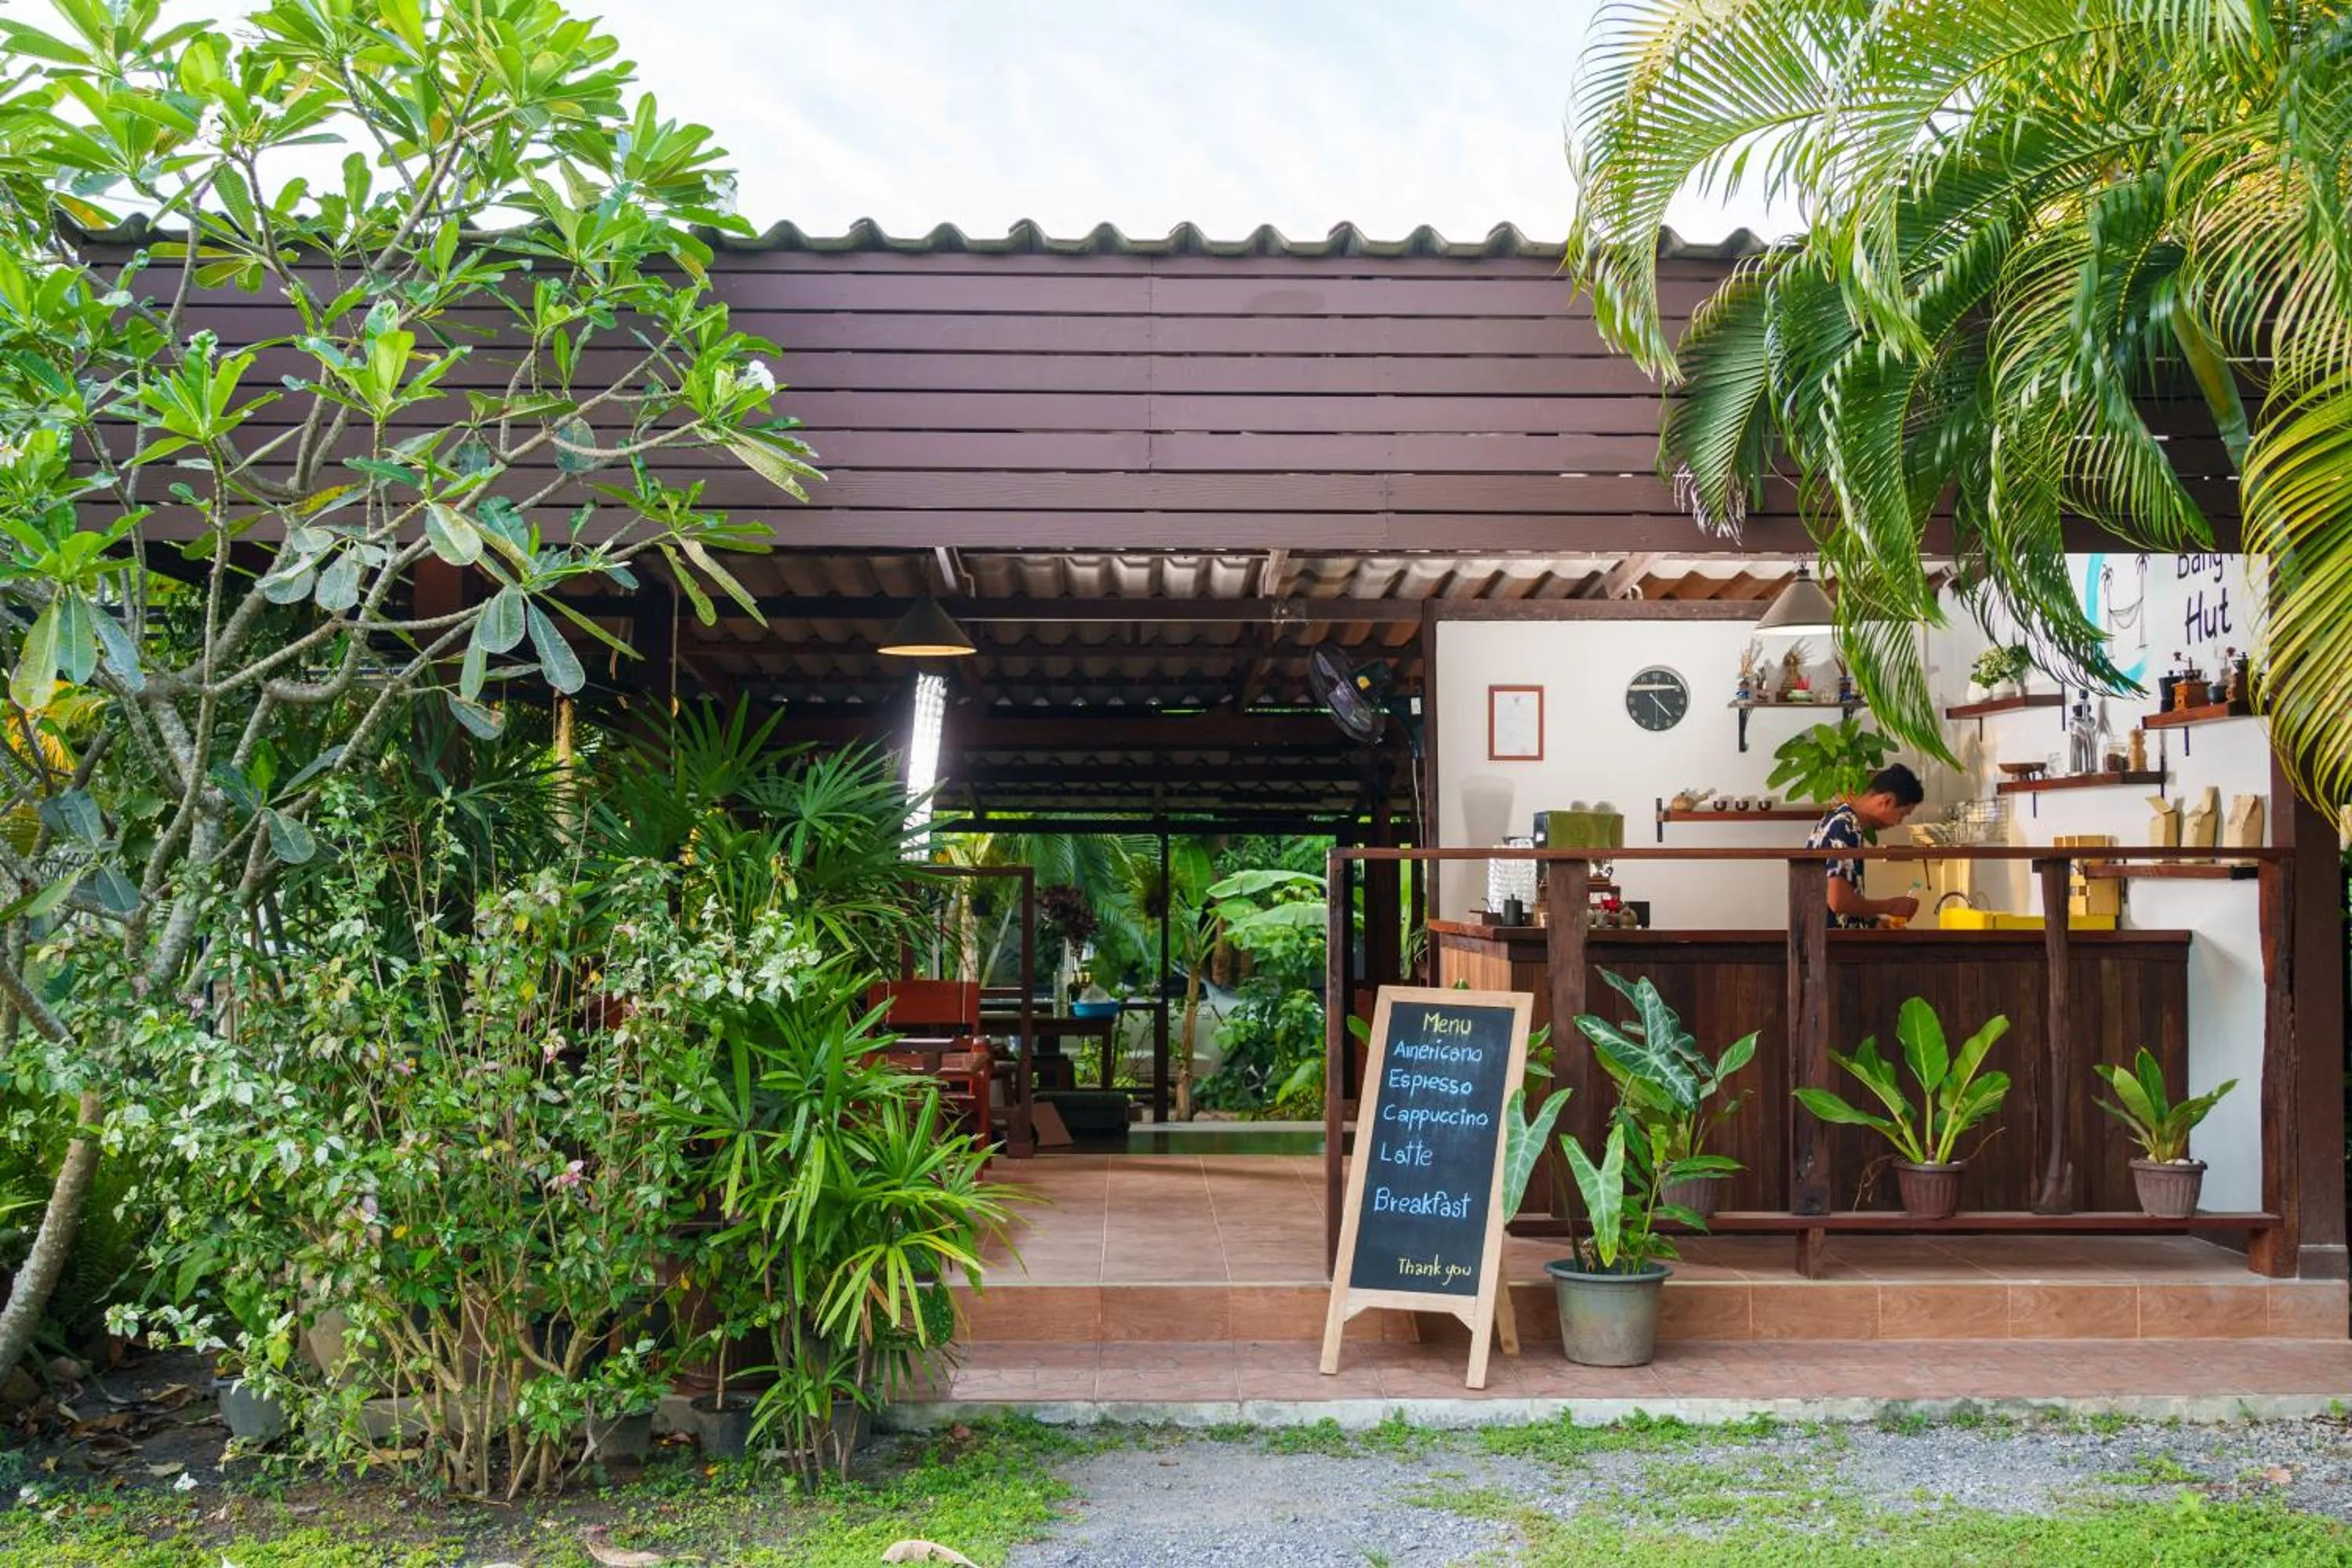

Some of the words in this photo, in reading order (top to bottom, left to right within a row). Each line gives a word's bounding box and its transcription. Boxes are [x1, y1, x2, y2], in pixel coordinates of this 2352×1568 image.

[2185, 588, 2232, 645] Hut
[1423, 1011, 1472, 1034] Menu
[1392, 1039, 1483, 1062] Americano
[1382, 1104, 1489, 1131] Cappuccino
[1380, 1140, 1432, 1167] Latte
[1374, 1187, 1472, 1218] Breakfast
[1399, 1254, 1442, 1276] Thank
[1443, 1265, 1472, 1286] you
